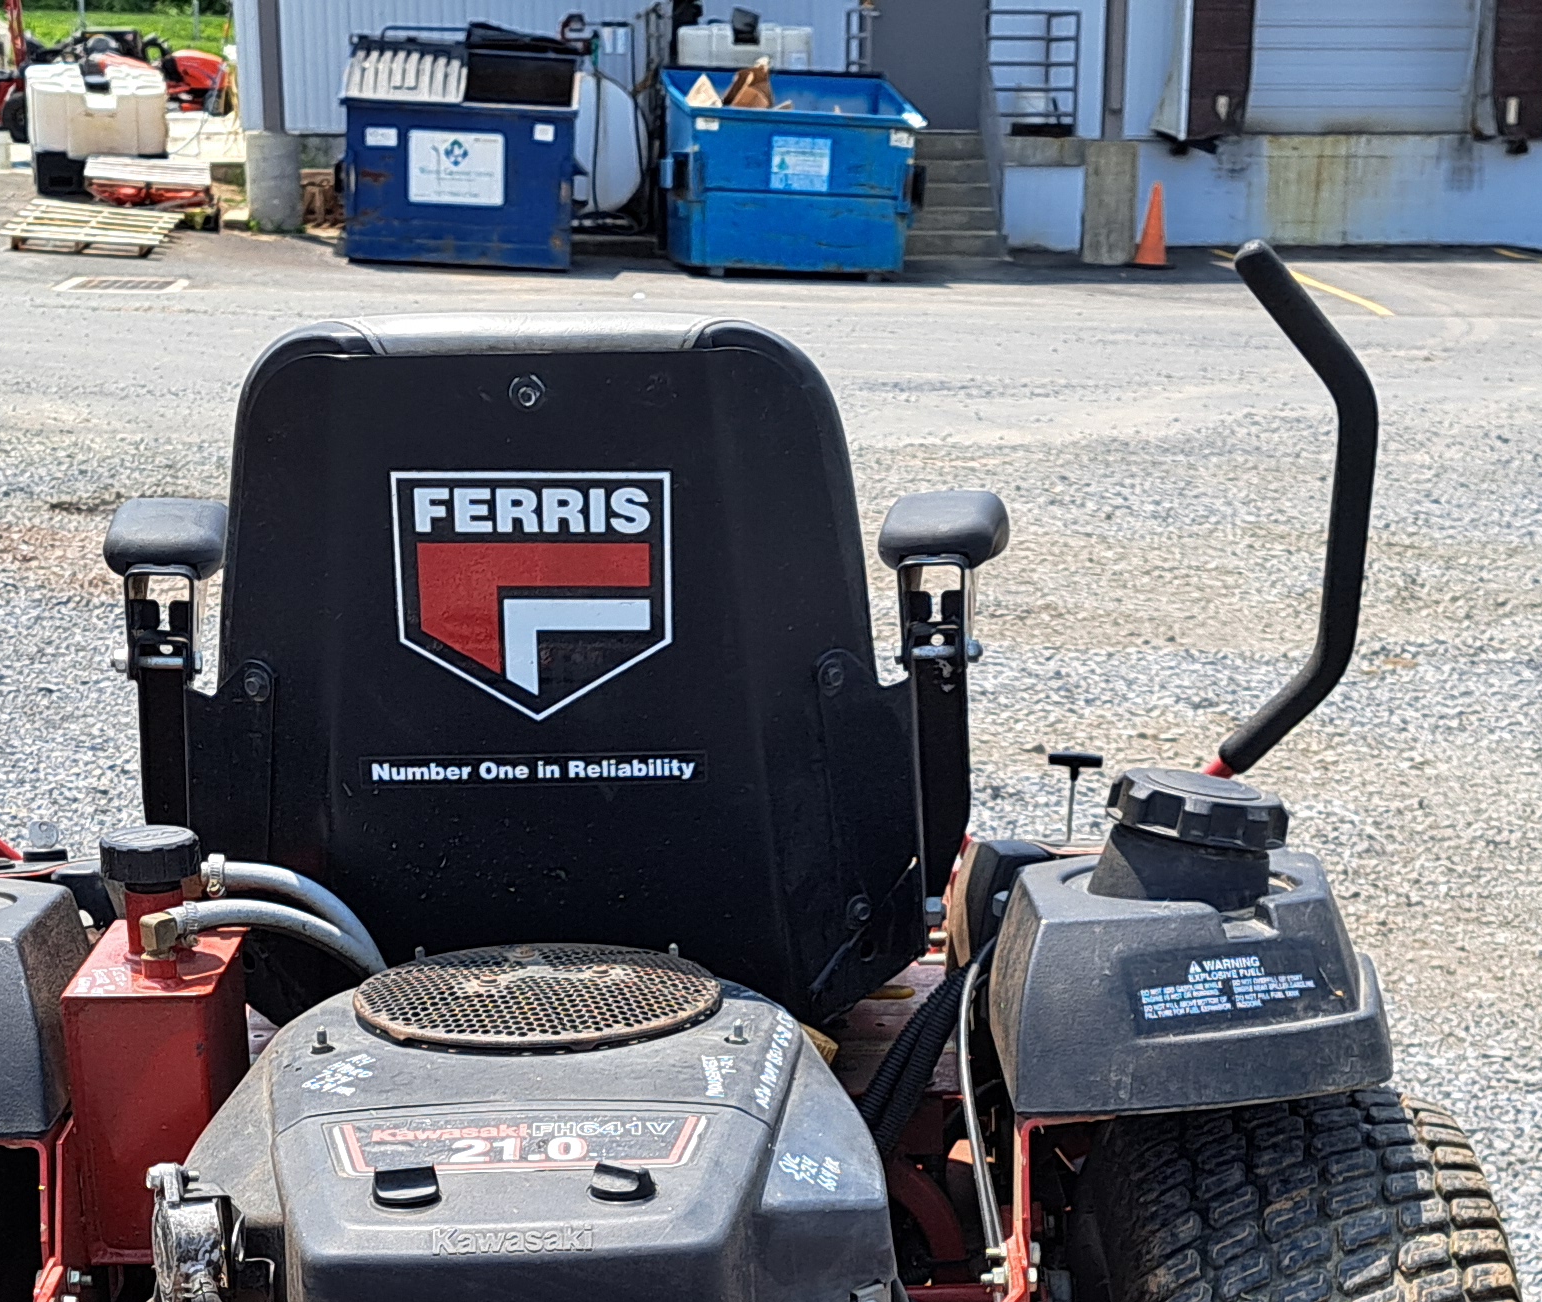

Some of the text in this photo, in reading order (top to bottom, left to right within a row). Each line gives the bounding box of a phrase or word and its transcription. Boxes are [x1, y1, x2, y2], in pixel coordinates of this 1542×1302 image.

[413, 487, 651, 534] FERRIS
[371, 759, 696, 782] Number One in Reliability
[1188, 969, 1238, 982] EXPLOSIVE
[1202, 956, 1260, 972] WARNING
[371, 1120, 675, 1142] Kawasaki FH641V
[450, 1136, 588, 1163] 21.0
[432, 1223, 593, 1256] Kawasaki
